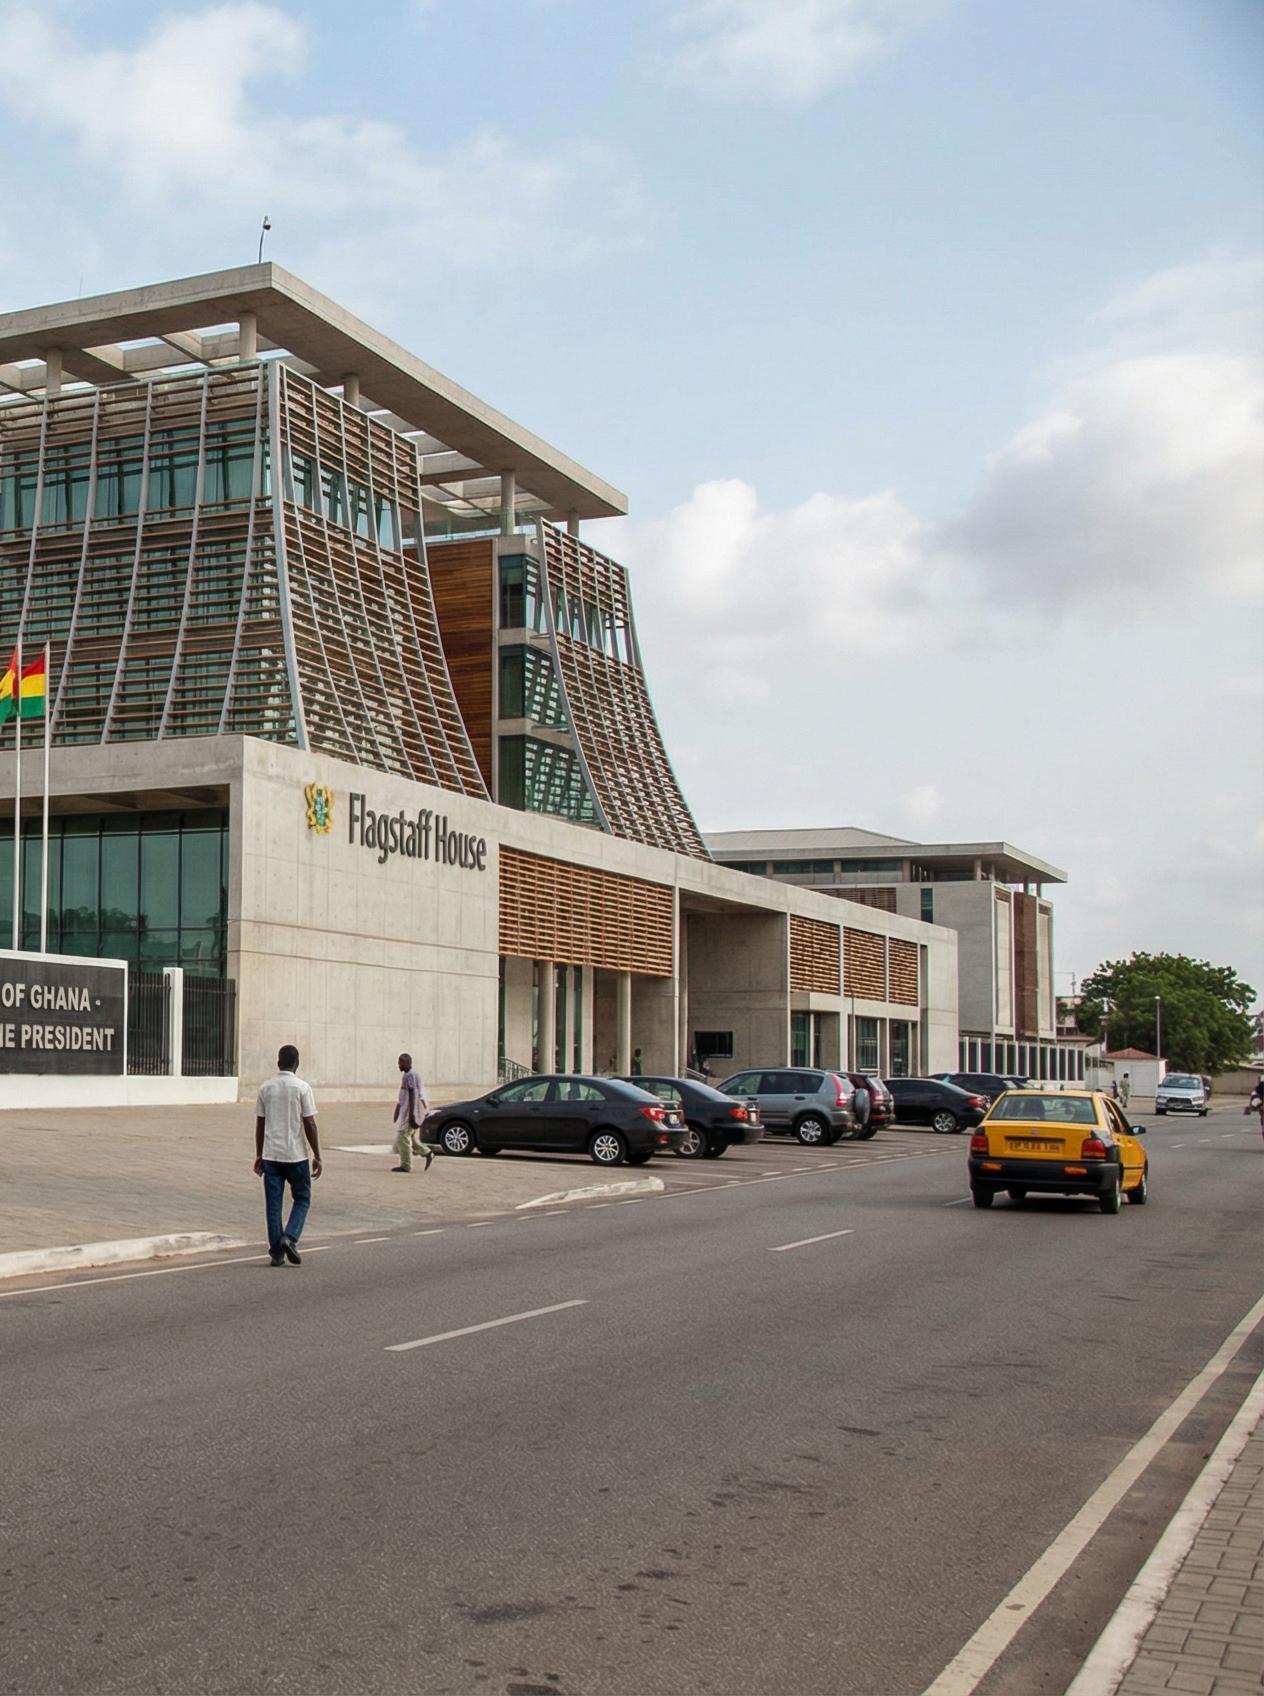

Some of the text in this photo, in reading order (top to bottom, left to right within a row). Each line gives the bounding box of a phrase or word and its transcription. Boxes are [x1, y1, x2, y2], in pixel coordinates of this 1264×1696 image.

[349, 792, 486, 871] Flagstaff House
[2, 983, 25, 1007] OF
[30, 984, 91, 1011] GHANA
[21, 1024, 114, 1051] PRESIDENT
